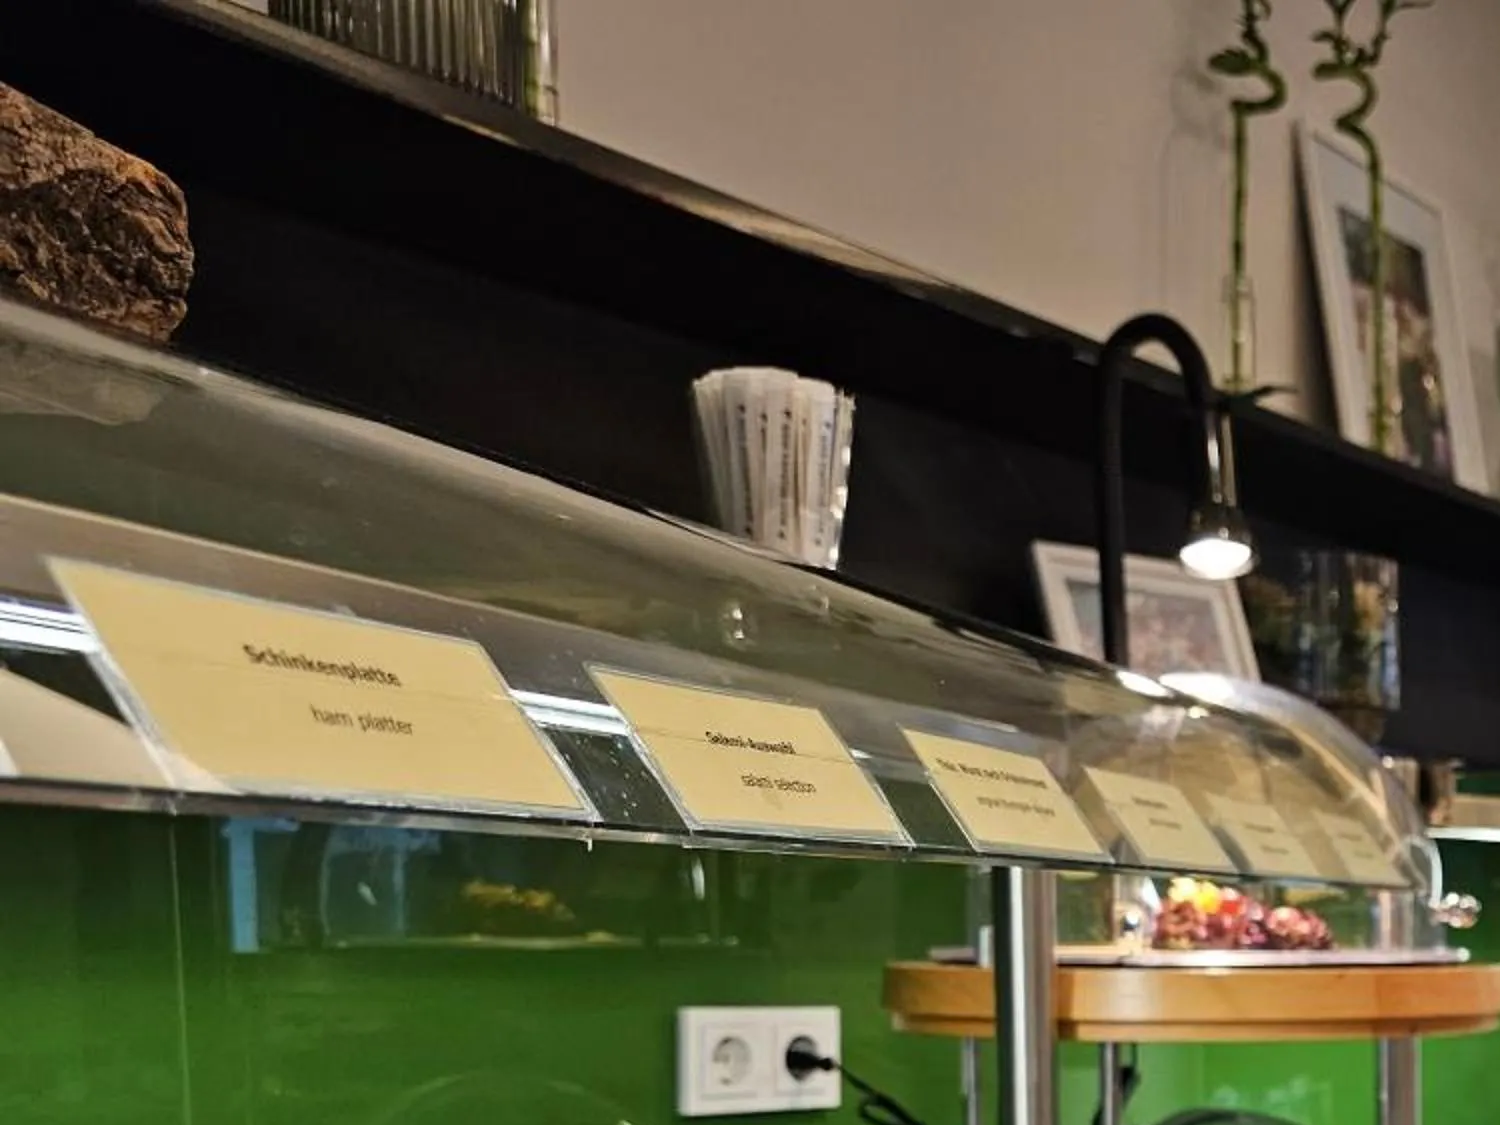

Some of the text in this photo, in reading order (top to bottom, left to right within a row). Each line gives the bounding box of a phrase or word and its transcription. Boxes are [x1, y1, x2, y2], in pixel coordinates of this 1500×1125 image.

[242, 643, 402, 687] Schinkenplatte
[309, 703, 413, 735] ham platter
